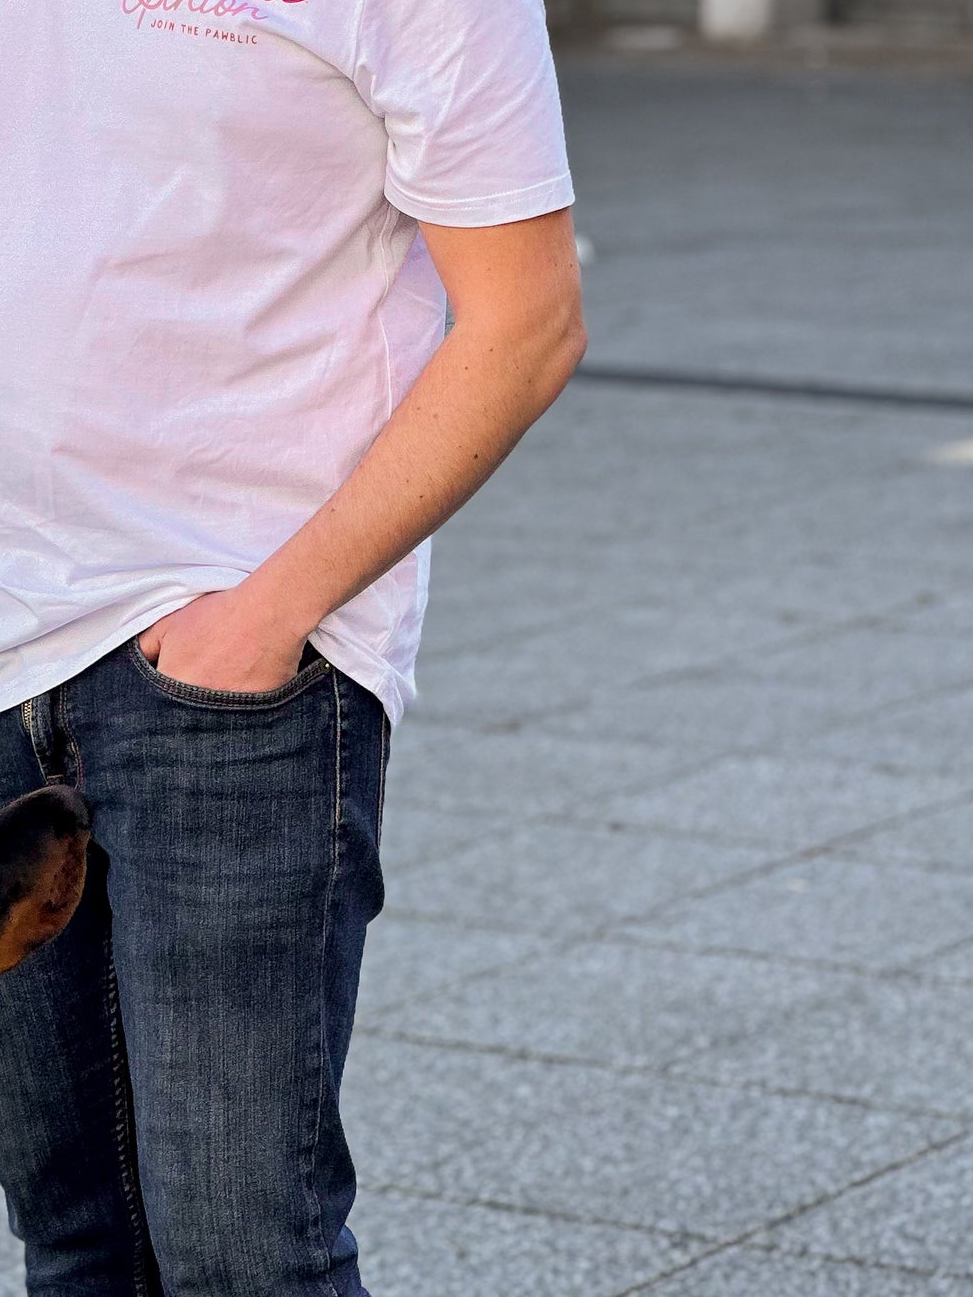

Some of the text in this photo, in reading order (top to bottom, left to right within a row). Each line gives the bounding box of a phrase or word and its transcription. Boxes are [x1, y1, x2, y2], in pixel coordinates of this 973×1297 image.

[150, 19, 258, 45] JOIN THE PAWBLIC
